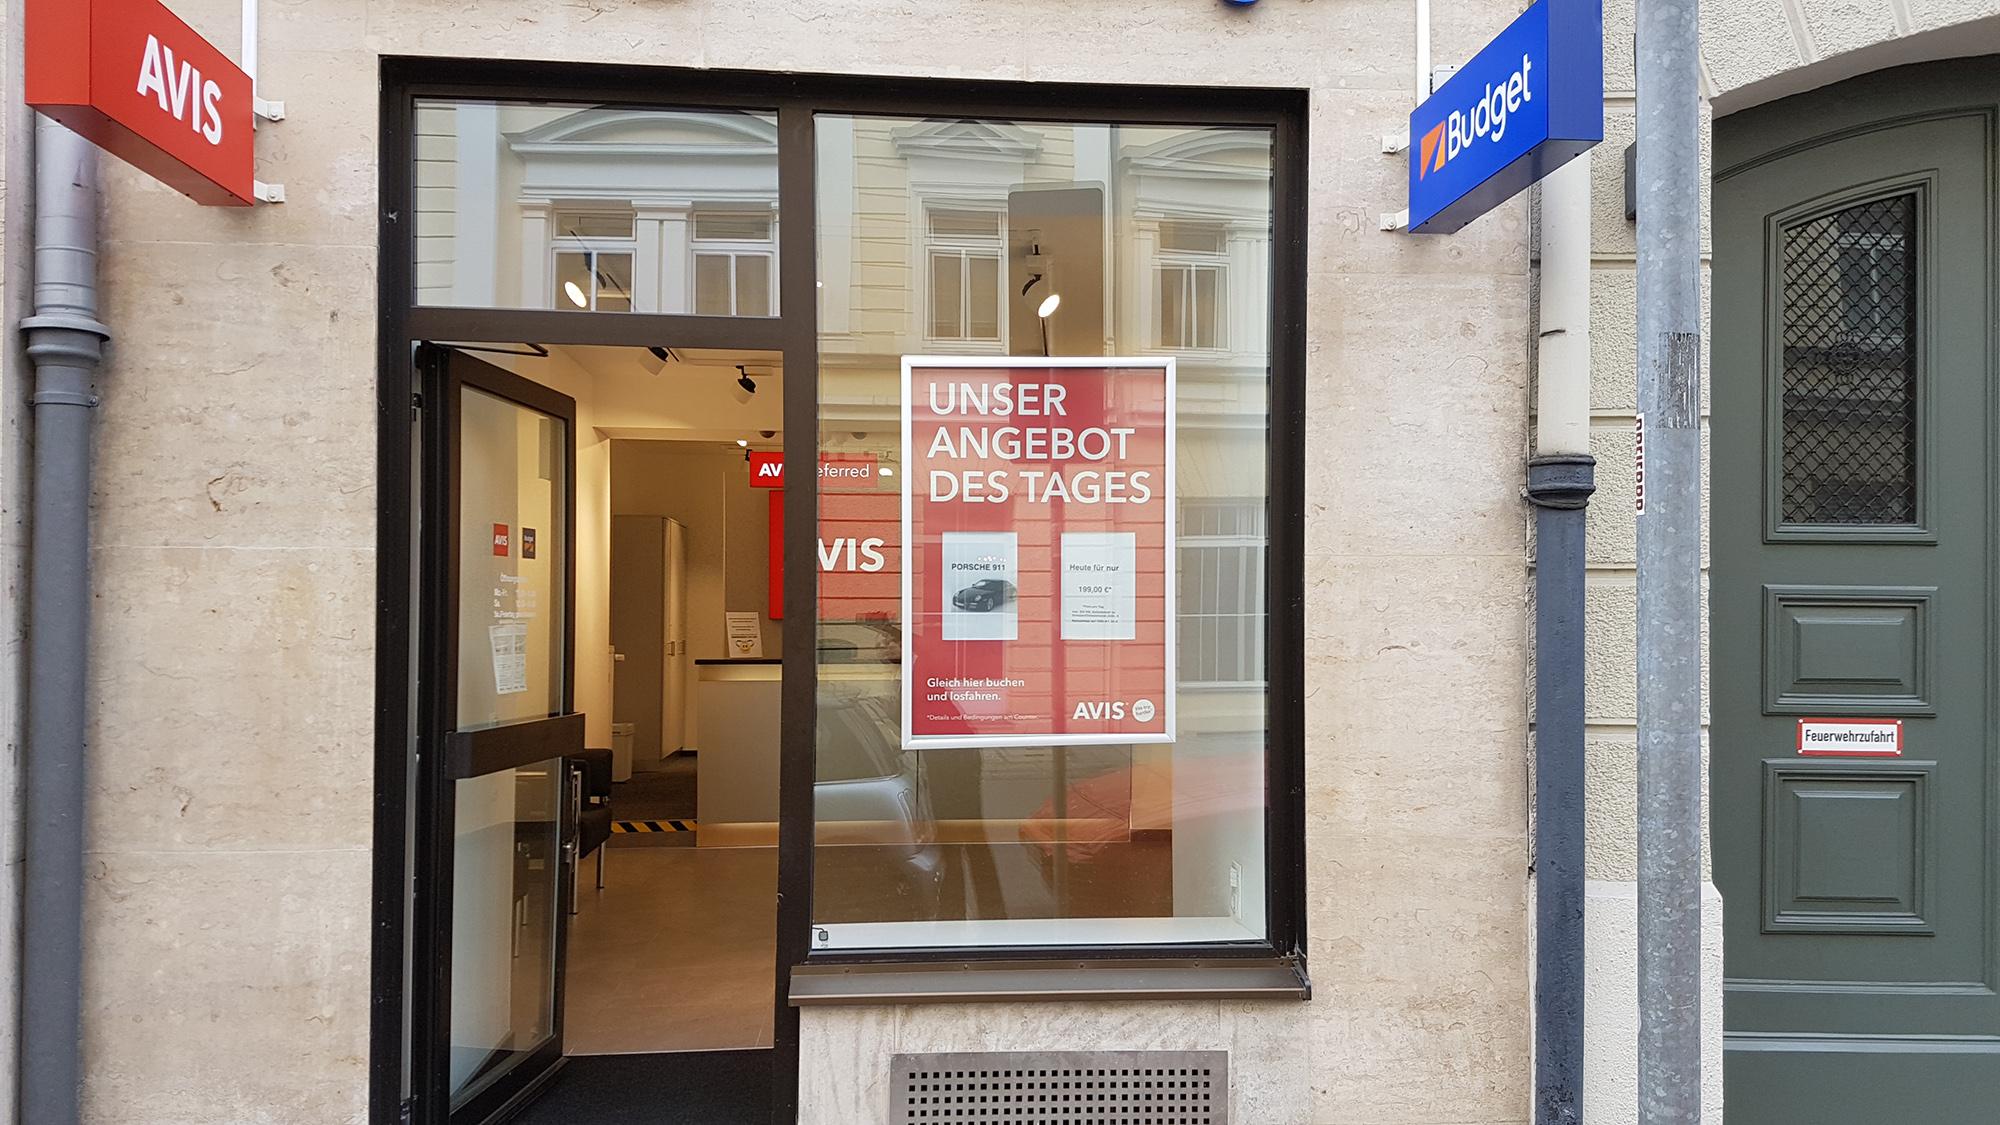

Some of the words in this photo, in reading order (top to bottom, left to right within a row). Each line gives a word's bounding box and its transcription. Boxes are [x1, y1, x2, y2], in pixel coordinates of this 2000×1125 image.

[136, 33, 222, 145] AVIS
[1448, 53, 1532, 162] Budget
[929, 382, 1067, 416] UNSER
[927, 426, 1135, 461] ANGEBOT
[758, 463, 783, 477] AV
[929, 470, 1009, 504] DES
[1019, 471, 1151, 504] TAGES
[817, 537, 885, 572] VIS
[951, 563, 991, 571] PORSCHE
[1093, 564, 1104, 572] für
[1078, 586, 1103, 594] 199,00
[927, 677, 960, 688] Gleich
[963, 677, 984, 688] hier
[986, 677, 1025, 688] buchen
[927, 691, 948, 702] und
[950, 691, 1001, 702] losfahren.
[1072, 701, 1125, 720] AVIS
[1805, 729, 1895, 743] Feuerwehrzufahrt
